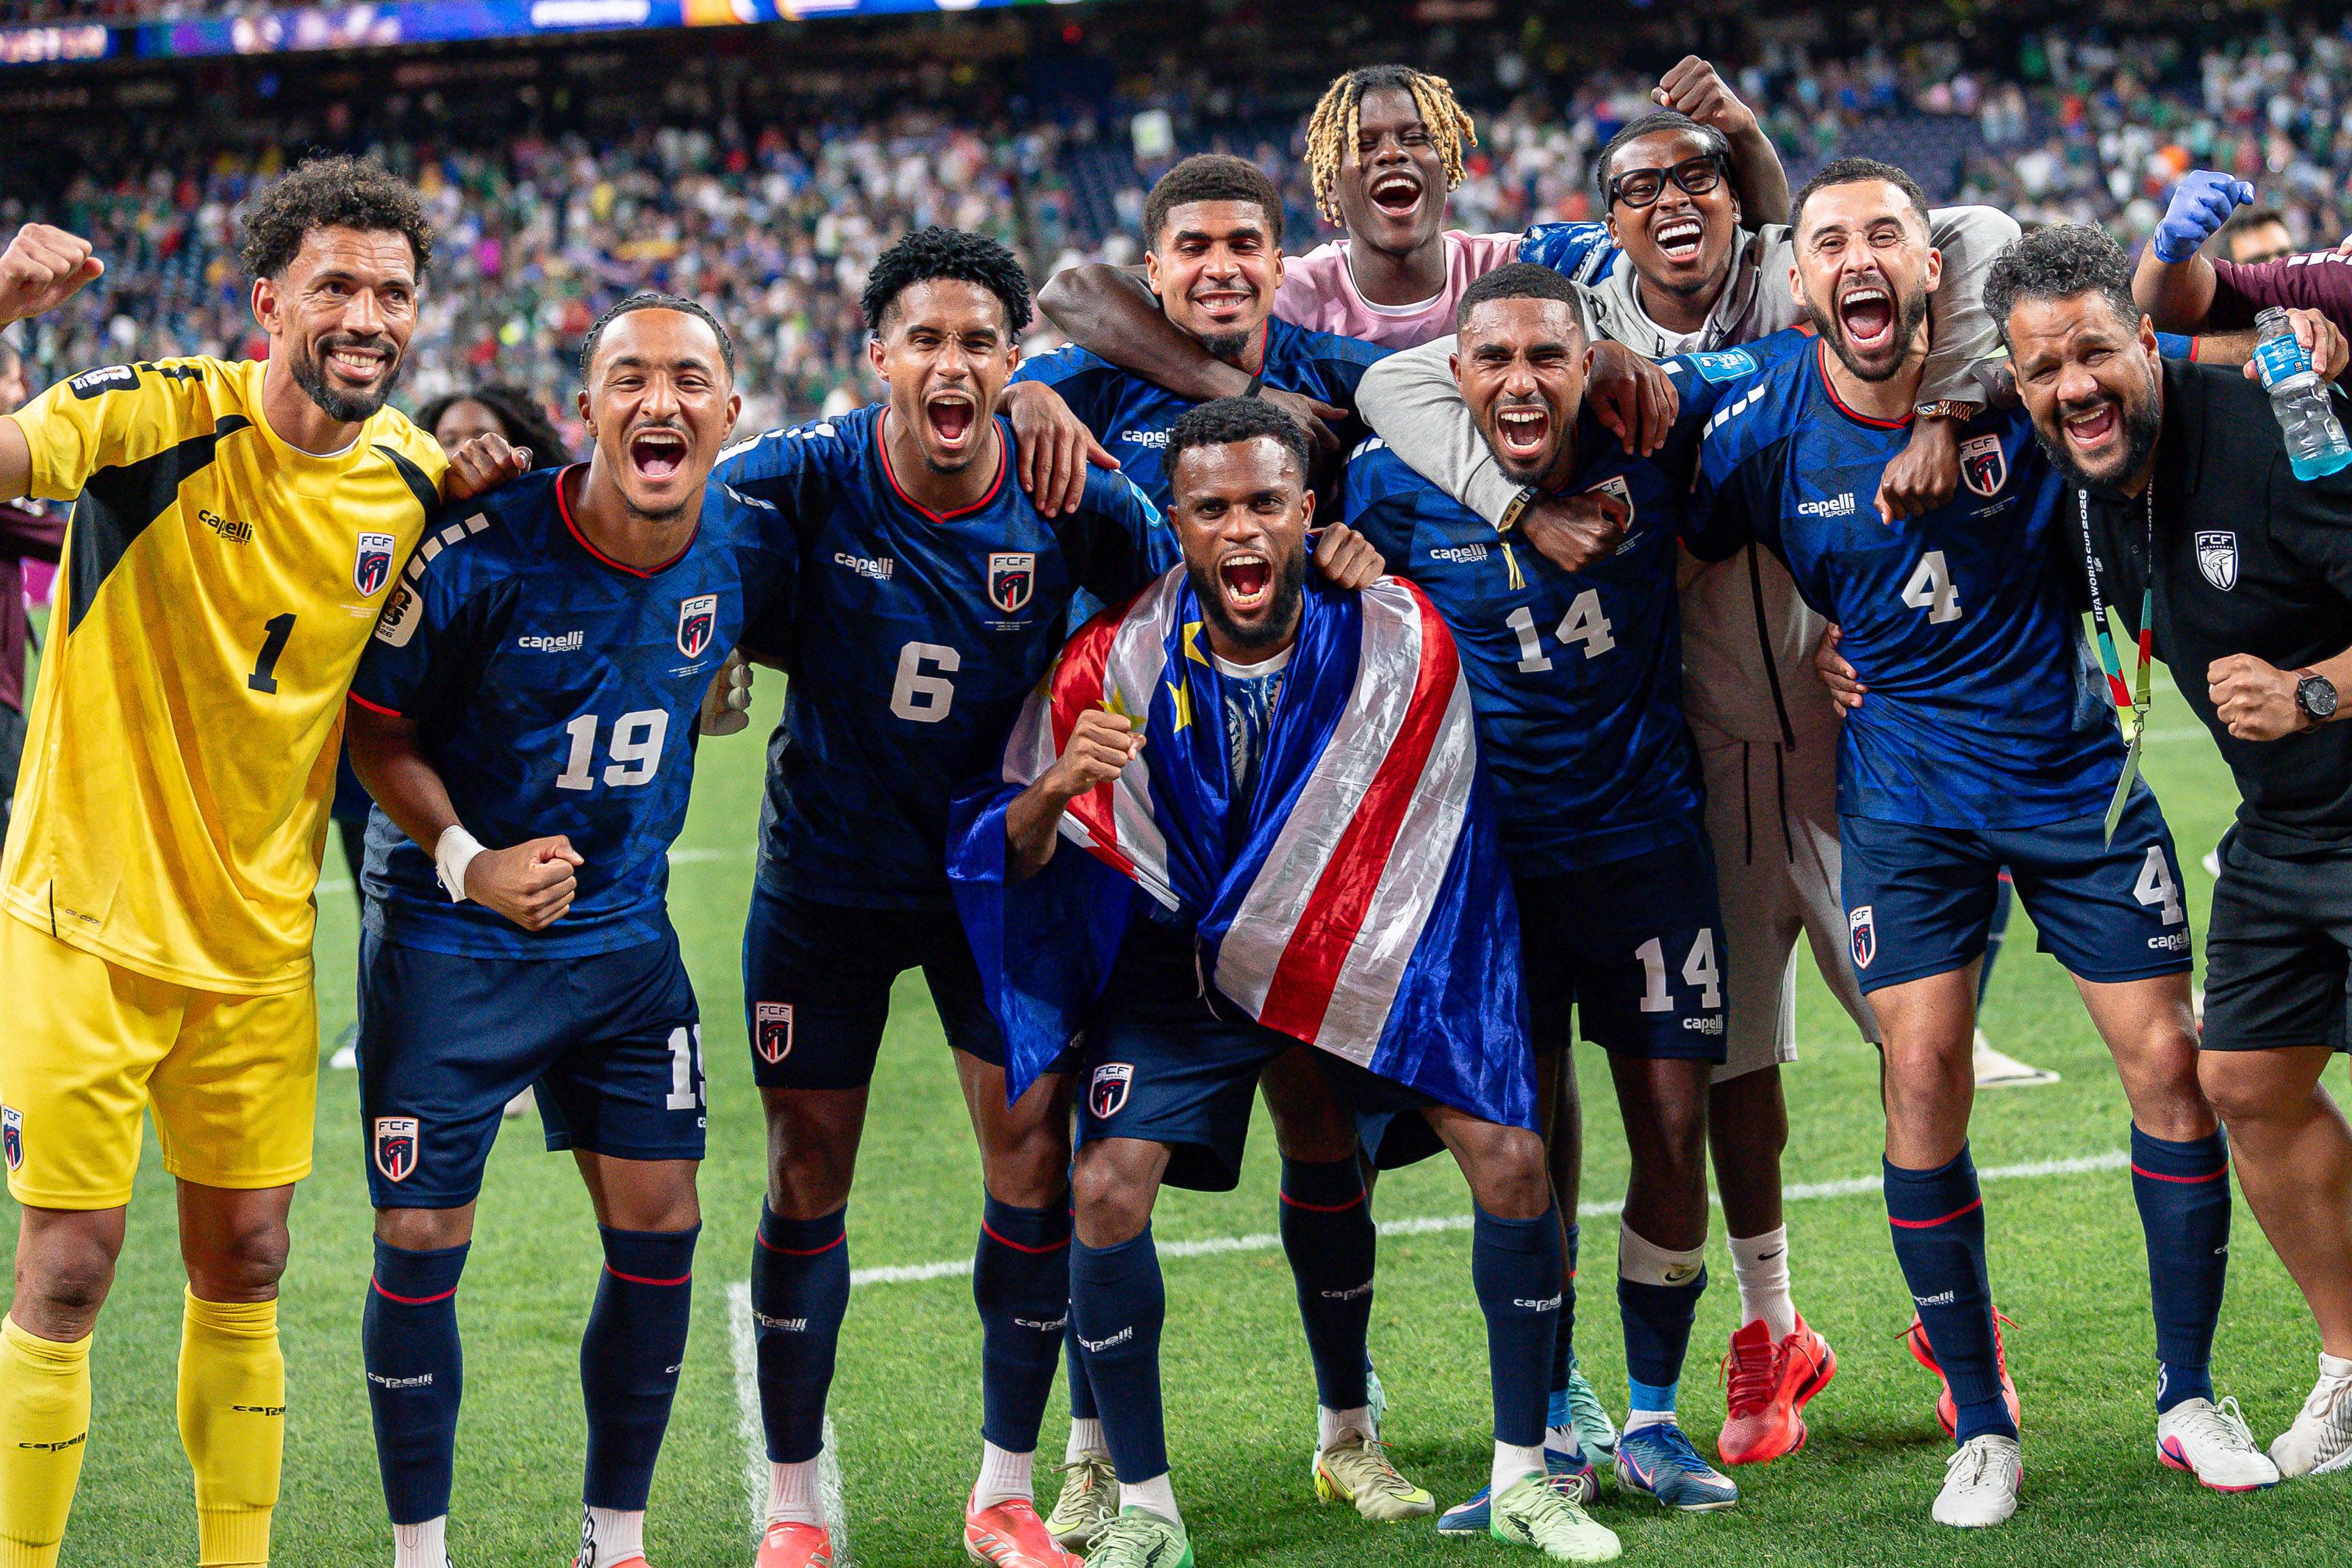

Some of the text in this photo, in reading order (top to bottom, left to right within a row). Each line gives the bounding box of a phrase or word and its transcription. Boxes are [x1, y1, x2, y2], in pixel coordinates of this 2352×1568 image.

[1122, 428, 1176, 447] capel
[1960, 437, 1995, 455] FCF
[1599, 479, 1621, 492] CF
[1797, 492, 1856, 517] capelli
[1825, 508, 1856, 518] SPORT
[2078, 489, 2089, 530] 2026
[198, 509, 253, 541] capelli
[361, 536, 392, 547] FCF
[2083, 531, 2092, 554] CUP
[2198, 534, 2232, 545] FCF
[994, 557, 1031, 567] FCF
[1430, 544, 1487, 561] capelli
[1458, 554, 1488, 564] SPORT
[834, 553, 894, 575] capelli
[861, 571, 892, 581] SPORT
[2085, 555, 2100, 597] WORLD
[1901, 550, 1962, 625] 4
[684, 599, 714, 614] FCF
[2093, 597, 2106, 622] FIFA
[518, 630, 584, 651] capelli
[1505, 589, 1616, 673] 14
[248, 612, 298, 695] 1
[548, 644, 583, 653] SPORT
[889, 641, 961, 723] 6
[556, 708, 669, 791] 19
[2132, 845, 2184, 926] 4
[1635, 928, 1721, 1013] 14
[759, 1005, 790, 1015] FCF
[1682, 1014, 1723, 1033] capelli
[1096, 1065, 1130, 1077] FCF
[379, 1121, 415, 1131] FCF
